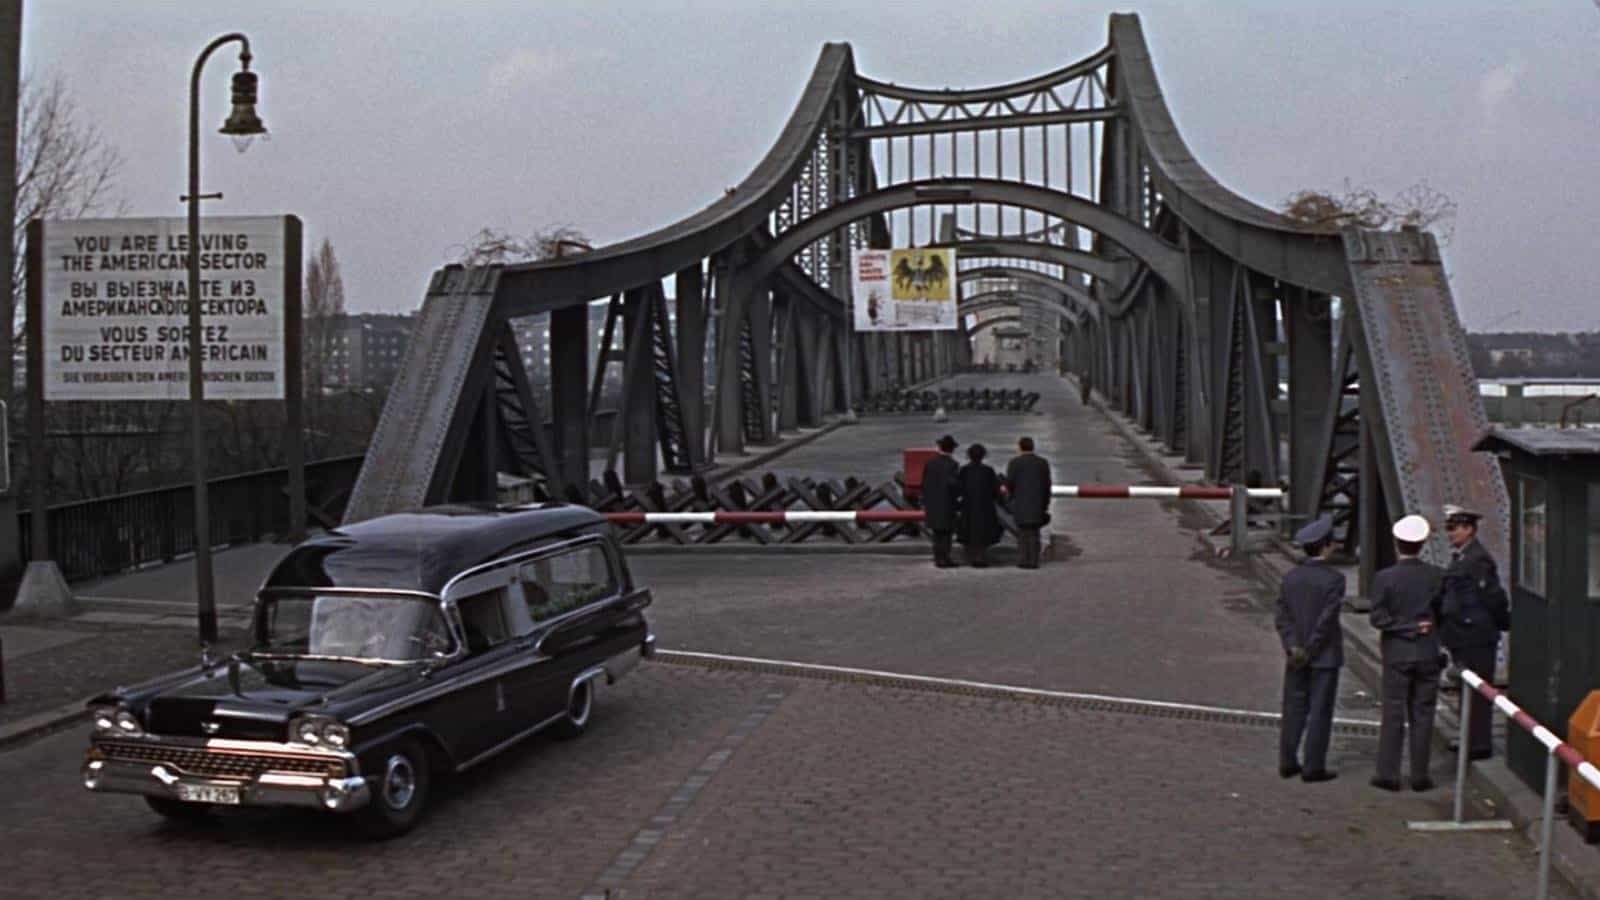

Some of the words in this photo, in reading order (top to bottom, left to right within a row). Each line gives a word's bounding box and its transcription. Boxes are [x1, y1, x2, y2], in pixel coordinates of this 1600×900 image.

[74, 236, 110, 253] YOU
[120, 235, 159, 252] ARE
[168, 234, 248, 252] LEVING
[62, 255, 94, 272] THE
[199, 253, 267, 270] SECTOR
[107, 280, 222, 297] ВЫЕЗЖАТЕ
[230, 280, 256, 297] ИЗ
[100, 326, 147, 343] VOUS
[157, 325, 229, 342] SOREZ
[61, 345, 84, 362] DU
[88, 344, 165, 361] SECTEUR
